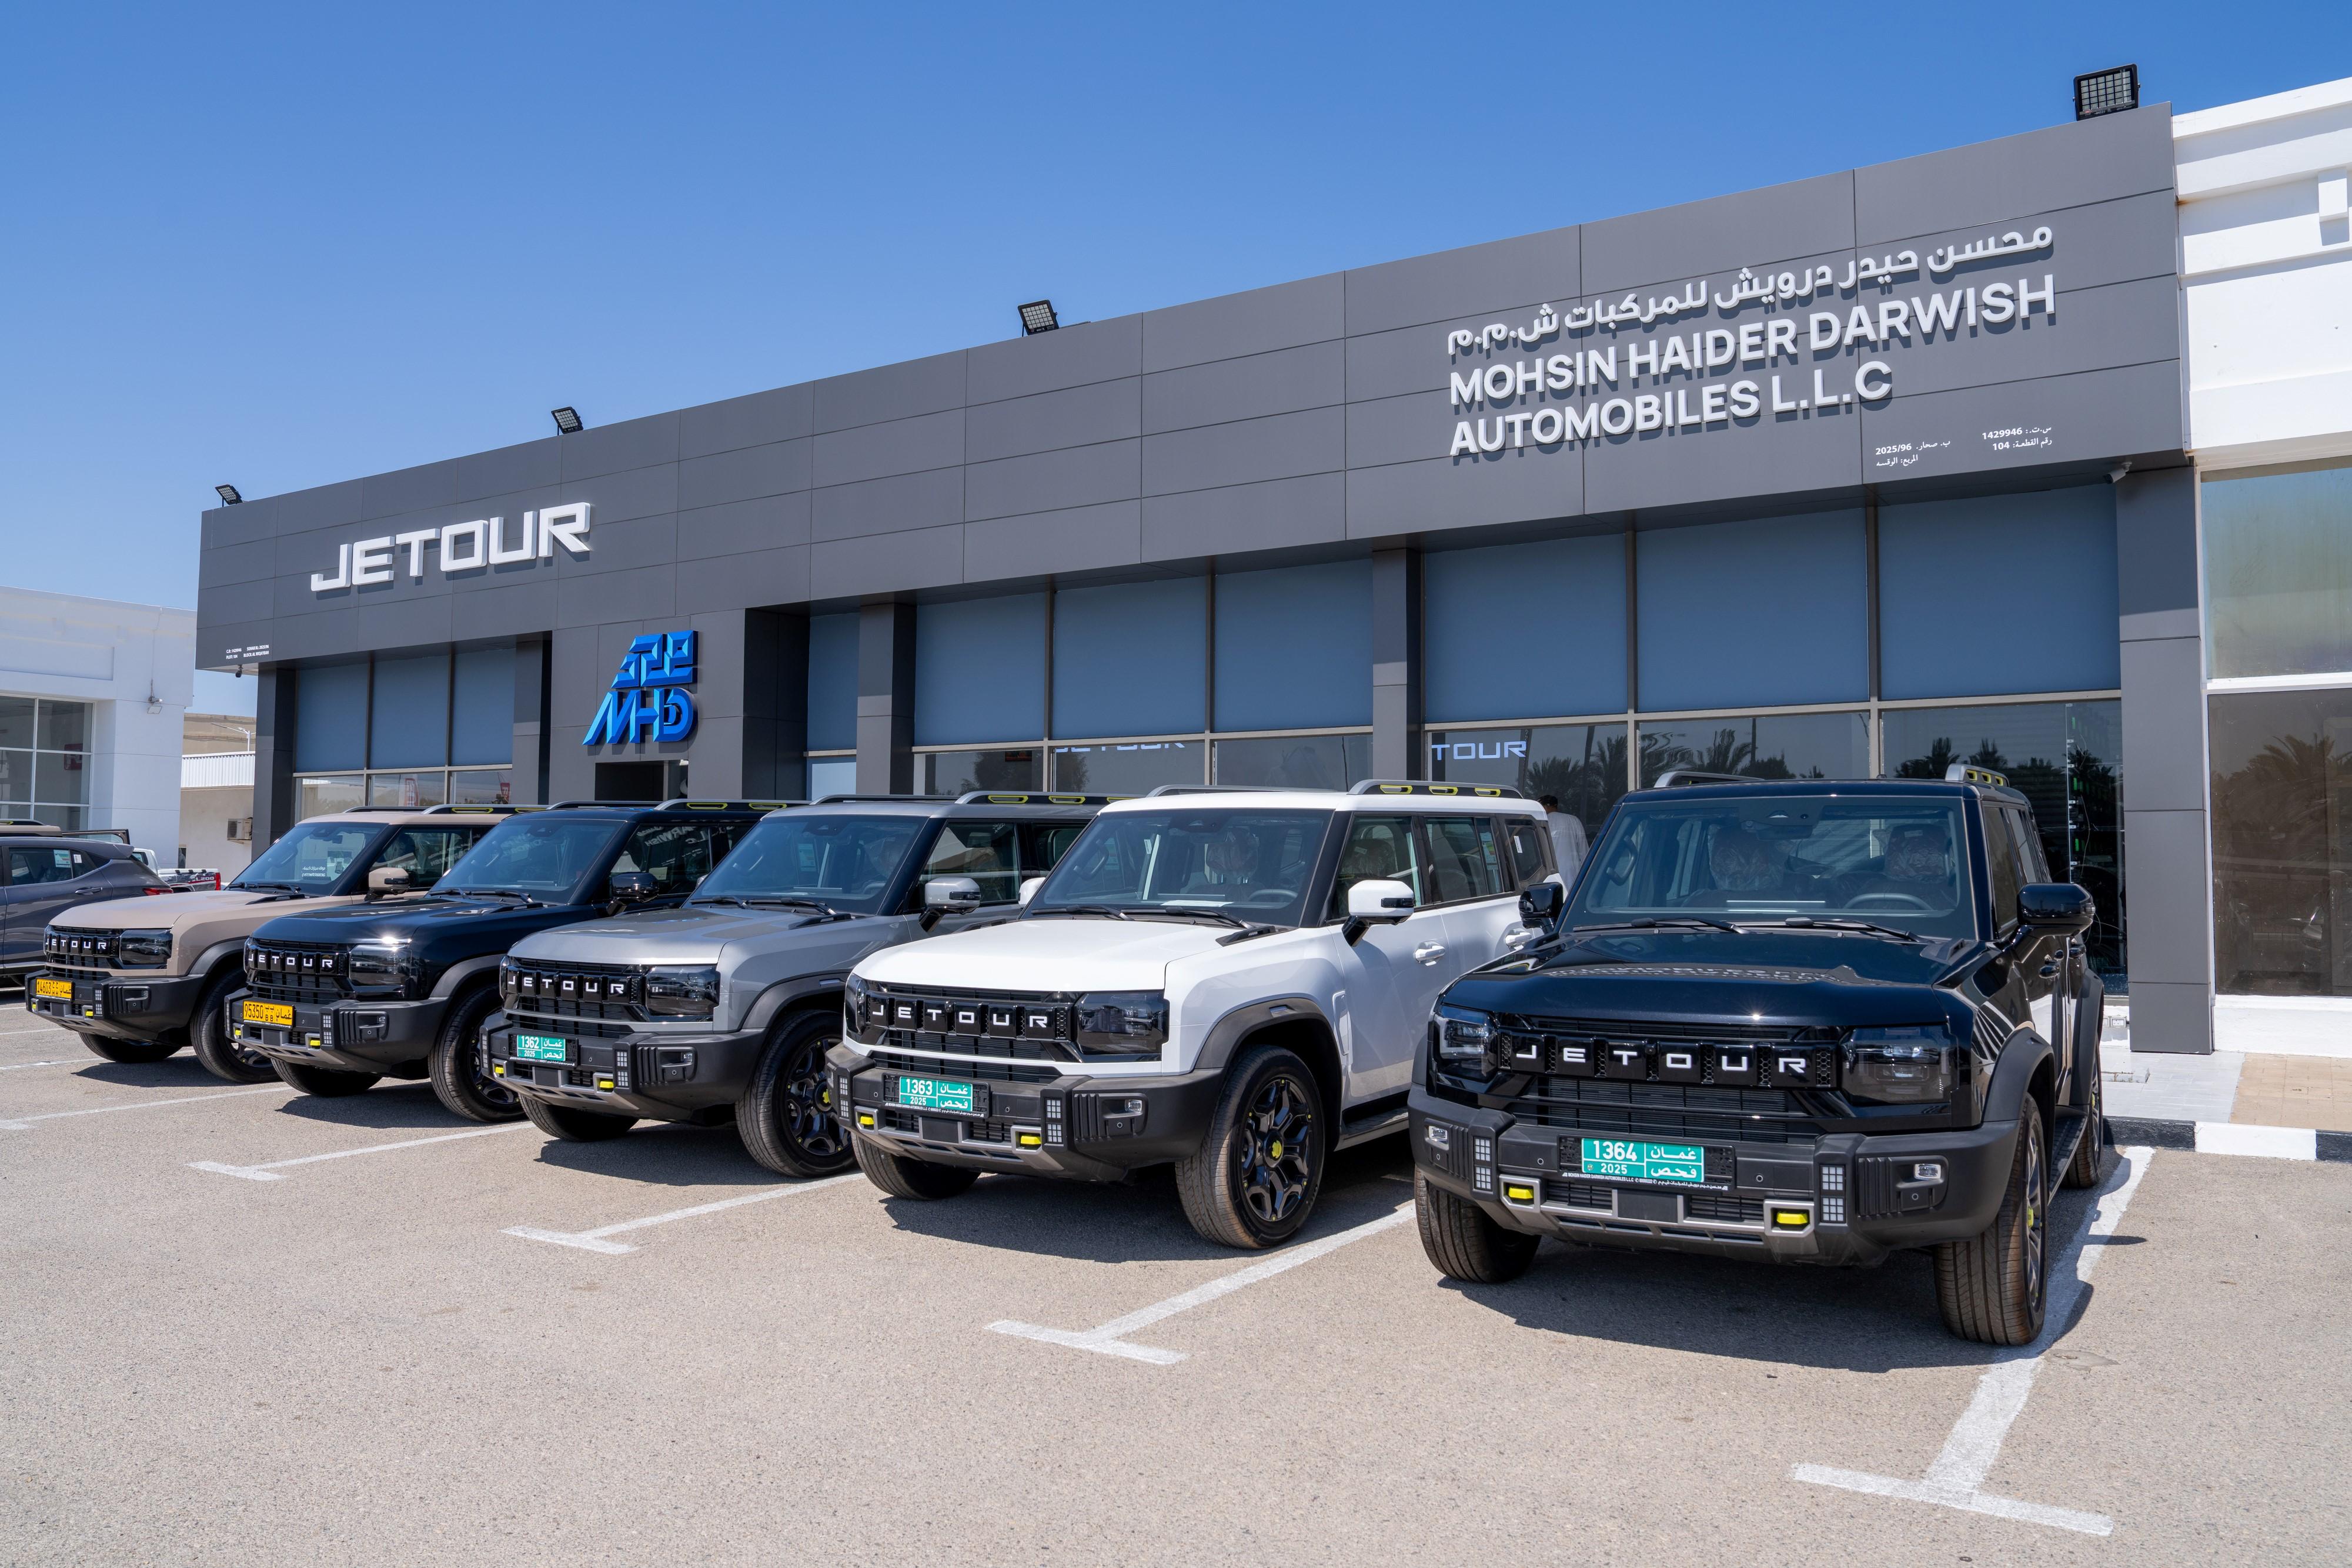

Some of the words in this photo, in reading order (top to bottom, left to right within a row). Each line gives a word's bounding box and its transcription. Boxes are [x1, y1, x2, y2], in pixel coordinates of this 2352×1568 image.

[1926, 226, 2053, 273] محسن
[1838, 249, 1919, 289] حيدر
[1713, 264, 1833, 309] درويش
[1564, 279, 1708, 330] للمركبات
[1450, 345, 1618, 406] MOHSIN
[1628, 318, 1799, 379] HAIDER
[1809, 273, 2056, 352] DARWISH
[1449, 379, 1761, 457] AUTOMOBILES
[1772, 360, 1892, 413] L.L.C
[1982, 427, 2023, 440] 1429946
[1875, 443, 1912, 455] 2025/96
[1992, 442, 2010, 450] 104
[2040, 437, 2052, 448] رقم
[310, 502, 593, 592] JETOUR
[582, 687, 697, 745] MHD
[45, 938, 107, 950] JETOUR
[248, 954, 333, 968] JETOUR
[37, 981, 51, 994] 14603
[507, 975, 624, 994] JETOUR
[245, 1003, 263, 1019] 95350
[871, 1005, 1048, 1029] JETOUR
[521, 1035, 540, 1049] 1362
[1515, 1045, 1806, 1074] JETOUR
[906, 1078, 933, 1095] 1363
[910, 1096, 927, 1106] 2025
[940, 1099, 969, 1109] فحص
[1592, 1140, 1638, 1162] 1364
[1600, 1163, 1628, 1175] 2025
[1650, 1165, 1698, 1179] فحص
